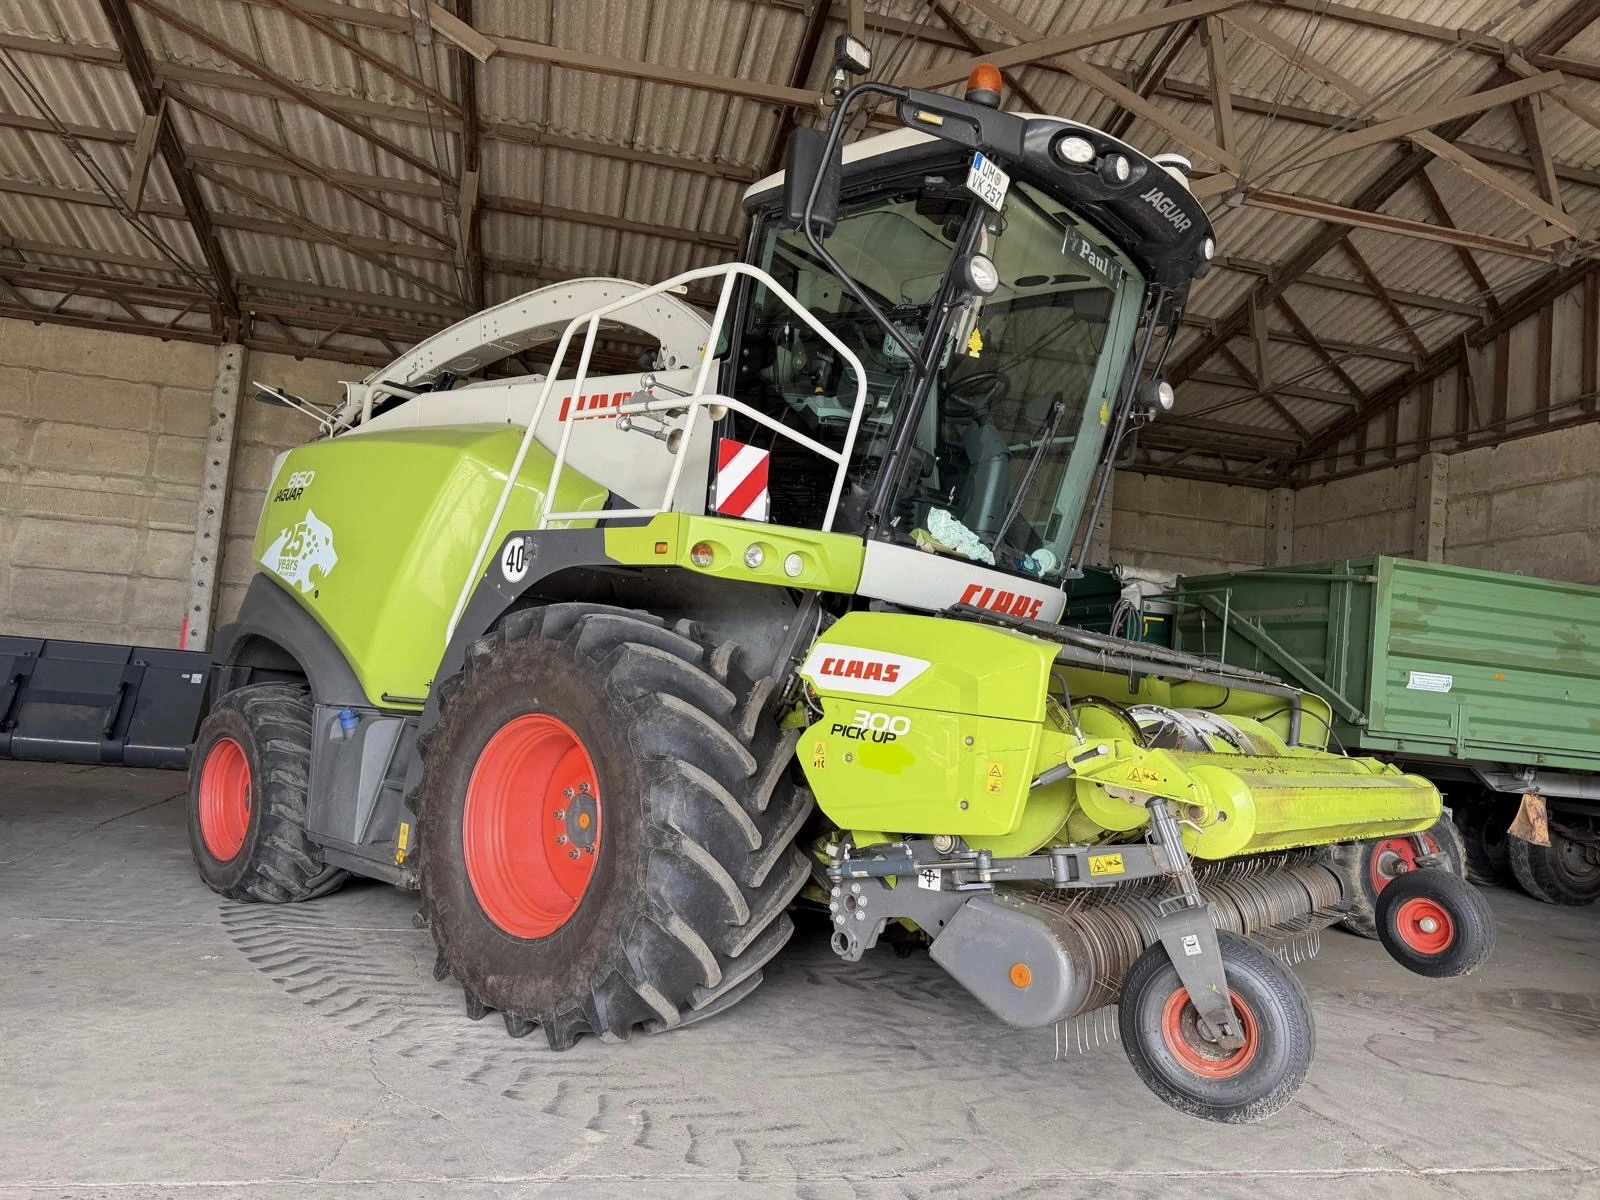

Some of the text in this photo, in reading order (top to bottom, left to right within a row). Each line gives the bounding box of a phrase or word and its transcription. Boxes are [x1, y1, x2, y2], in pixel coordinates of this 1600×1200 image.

[982, 161, 996, 182] UM
[972, 173, 1002, 206] VK 257
[1140, 187, 1192, 233] JAGUAR
[1079, 239, 1109, 276] Paul
[274, 488, 303, 502] JAGUAR
[280, 523, 308, 558] 25
[277, 558, 298, 572] years
[506, 545, 524, 573] 40
[820, 657, 901, 683] CLAAS
[830, 723, 897, 744] PICK UP
[851, 709, 912, 737] 300
